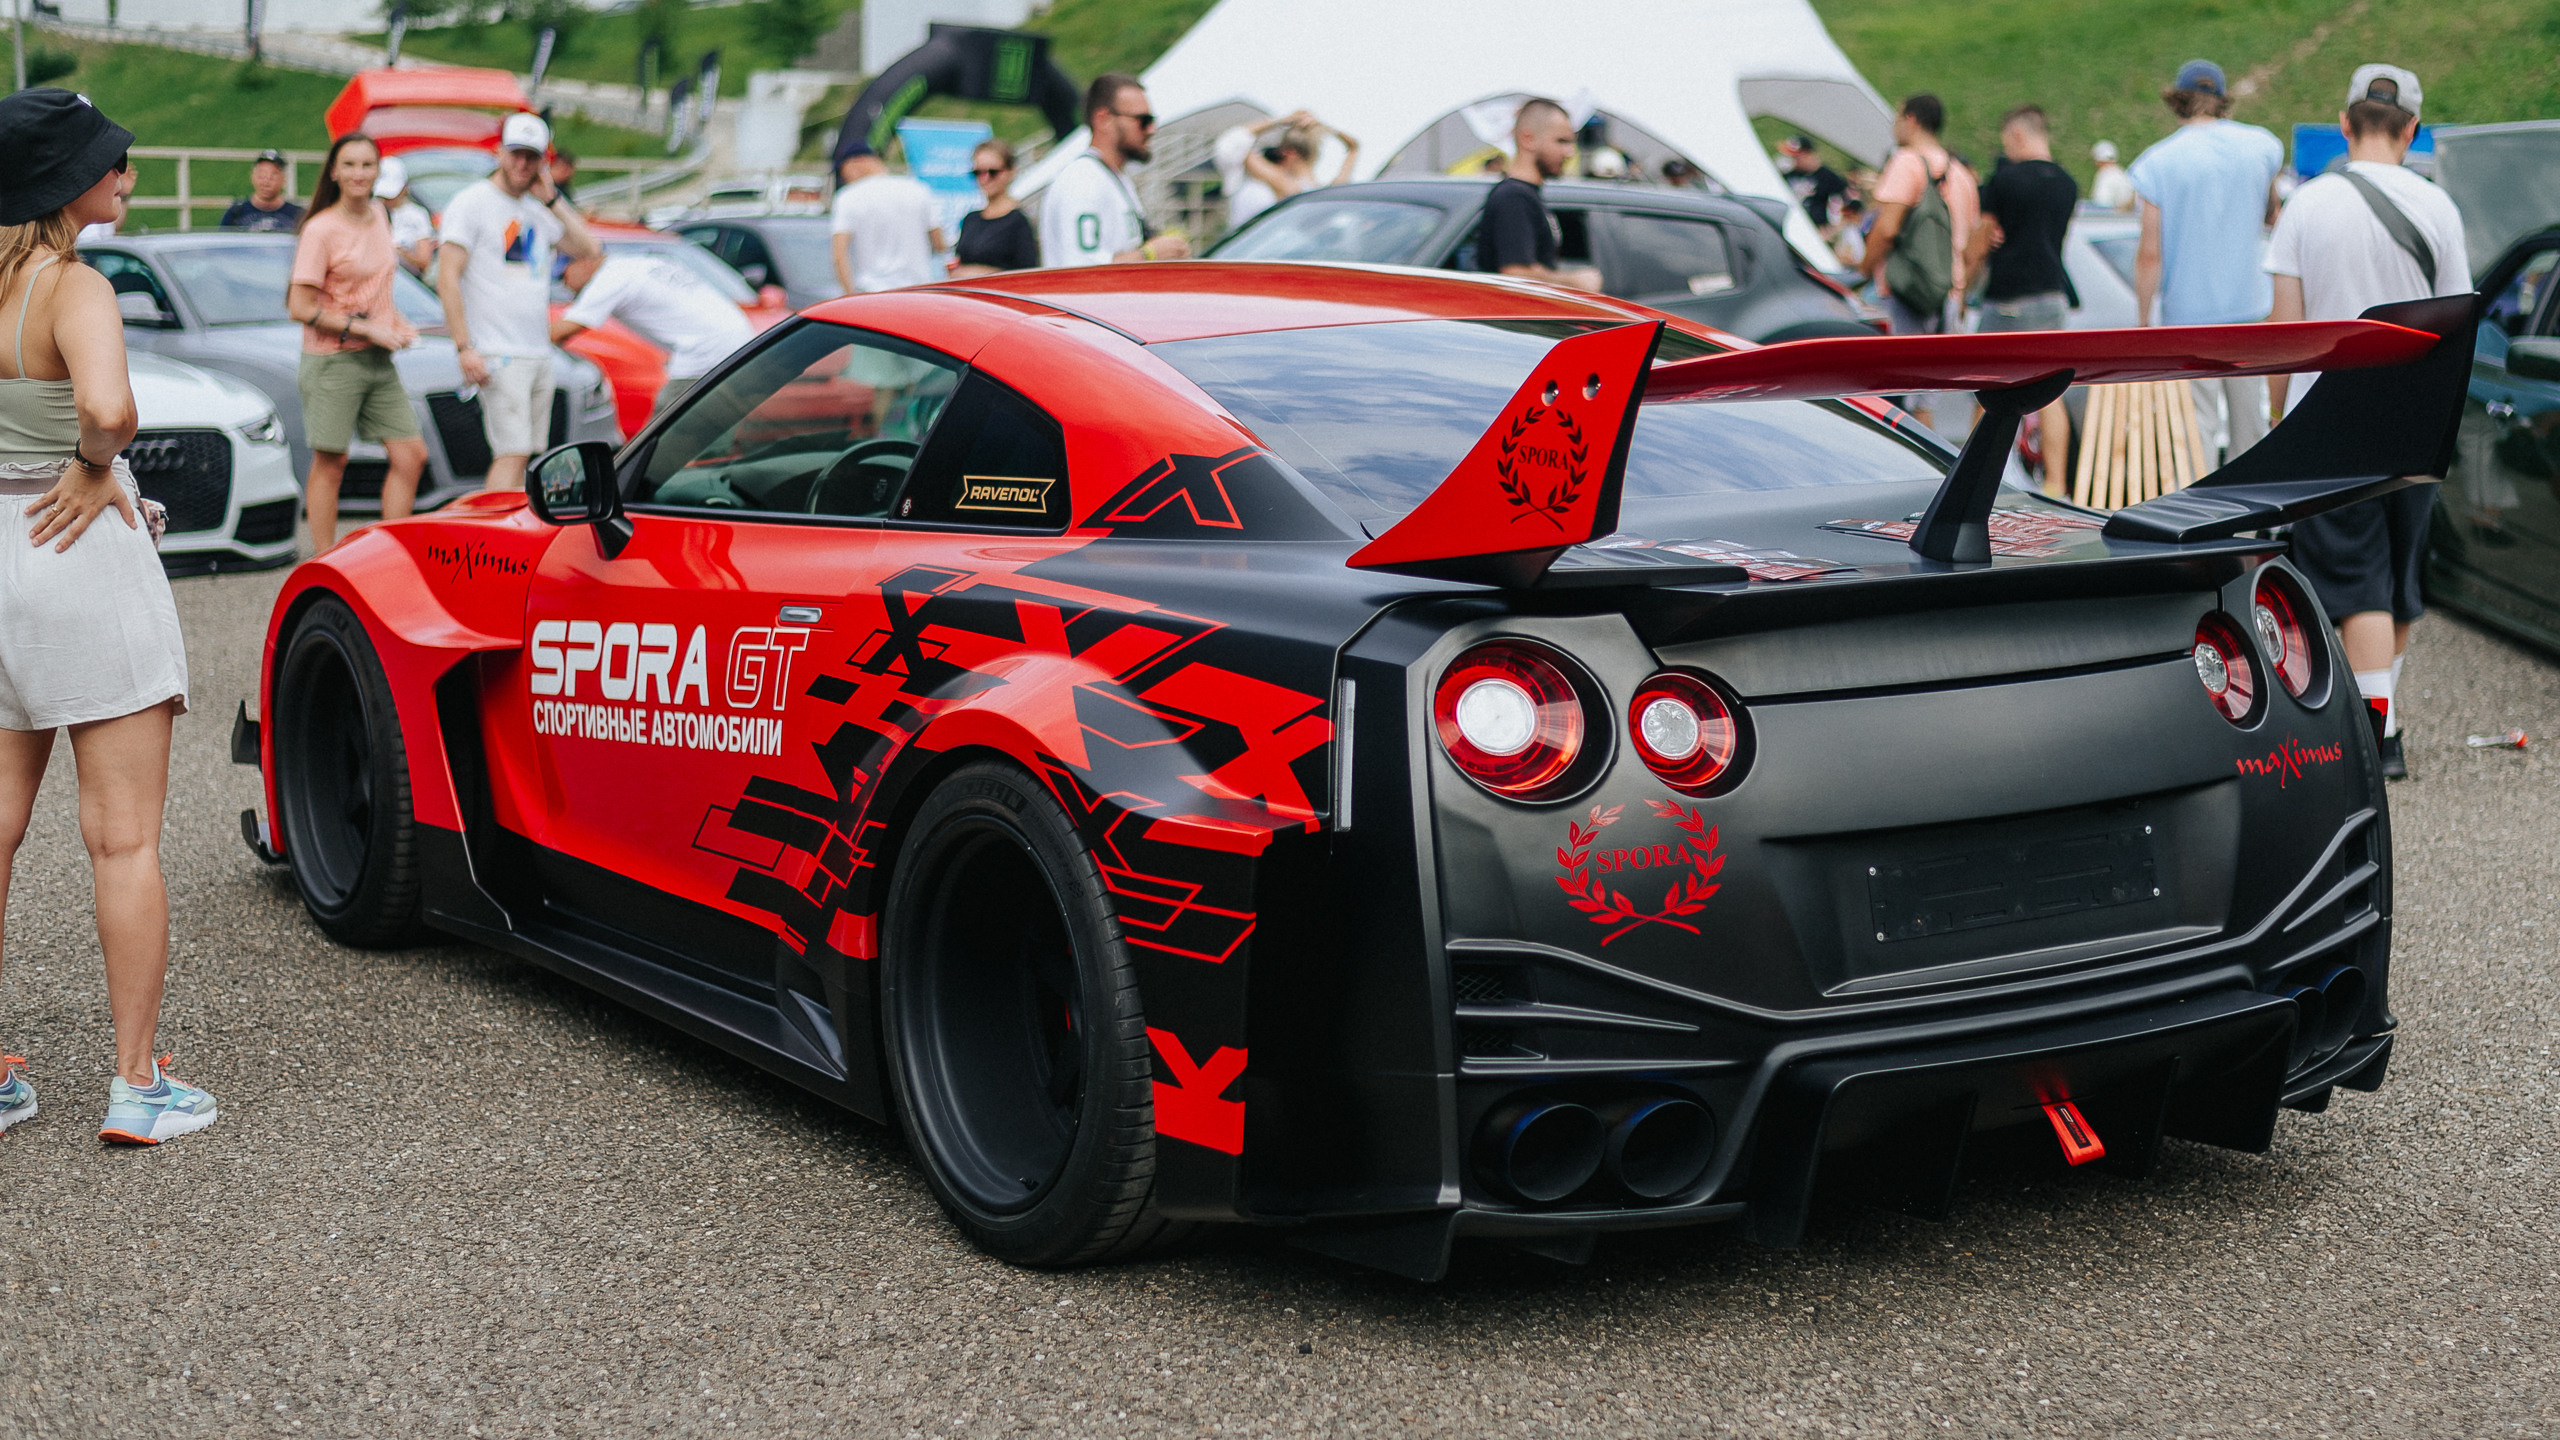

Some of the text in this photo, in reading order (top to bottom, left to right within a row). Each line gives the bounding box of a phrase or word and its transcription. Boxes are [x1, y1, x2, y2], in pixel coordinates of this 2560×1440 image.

[1516, 444, 1571, 471] SPORA
[530, 619, 811, 712] SPORA GT
[533, 699, 783, 757] СПОРТИВНЫЕ АВТОМОБИЛИ
[1595, 842, 1693, 874] SPORA
